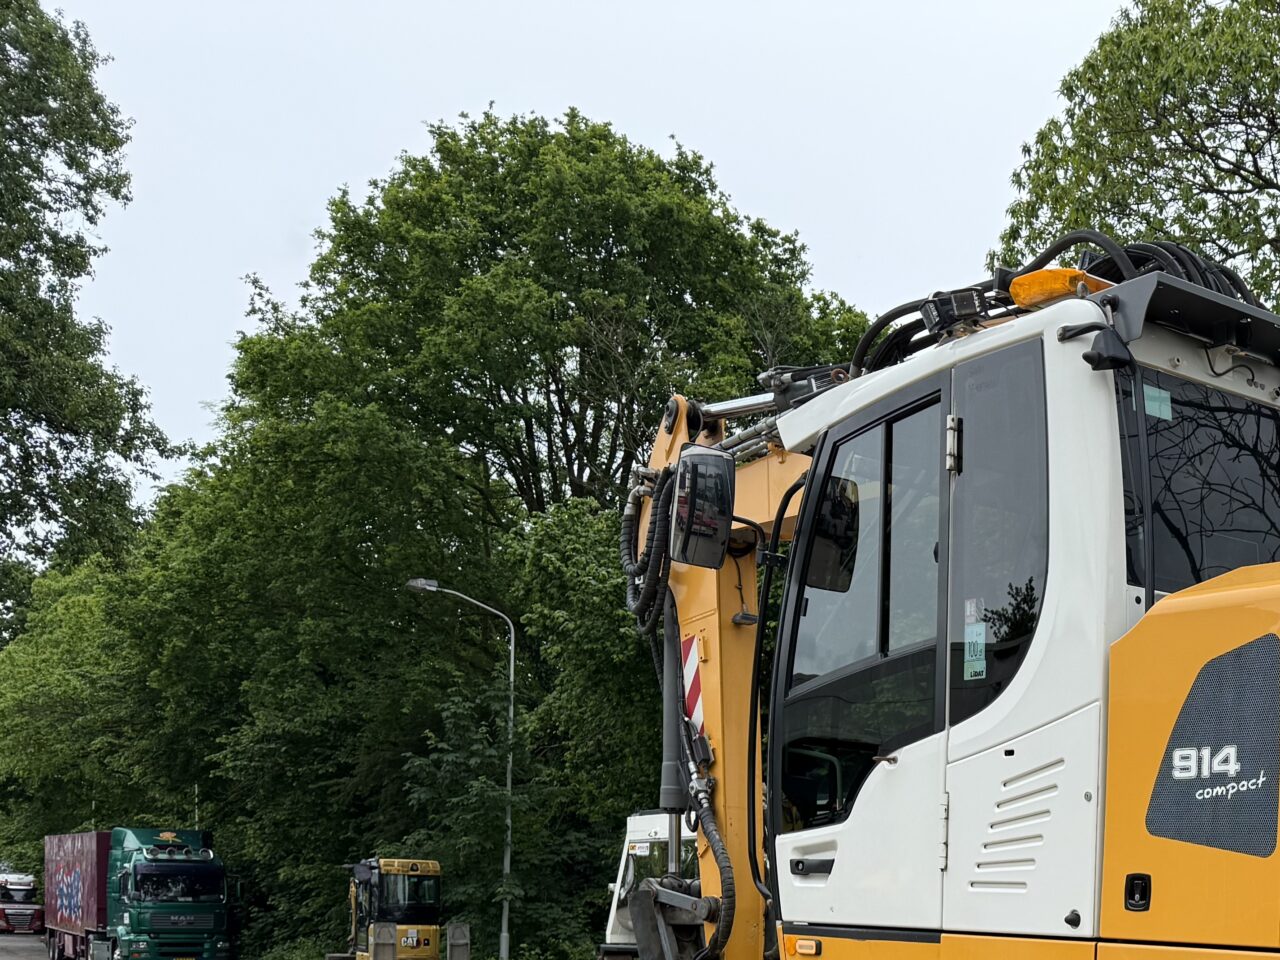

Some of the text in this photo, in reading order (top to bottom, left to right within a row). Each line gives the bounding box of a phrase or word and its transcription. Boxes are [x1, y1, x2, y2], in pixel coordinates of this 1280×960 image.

[1172, 745, 1241, 779] 914
[1195, 770, 1267, 799] compact
[401, 937, 418, 947] CAT
